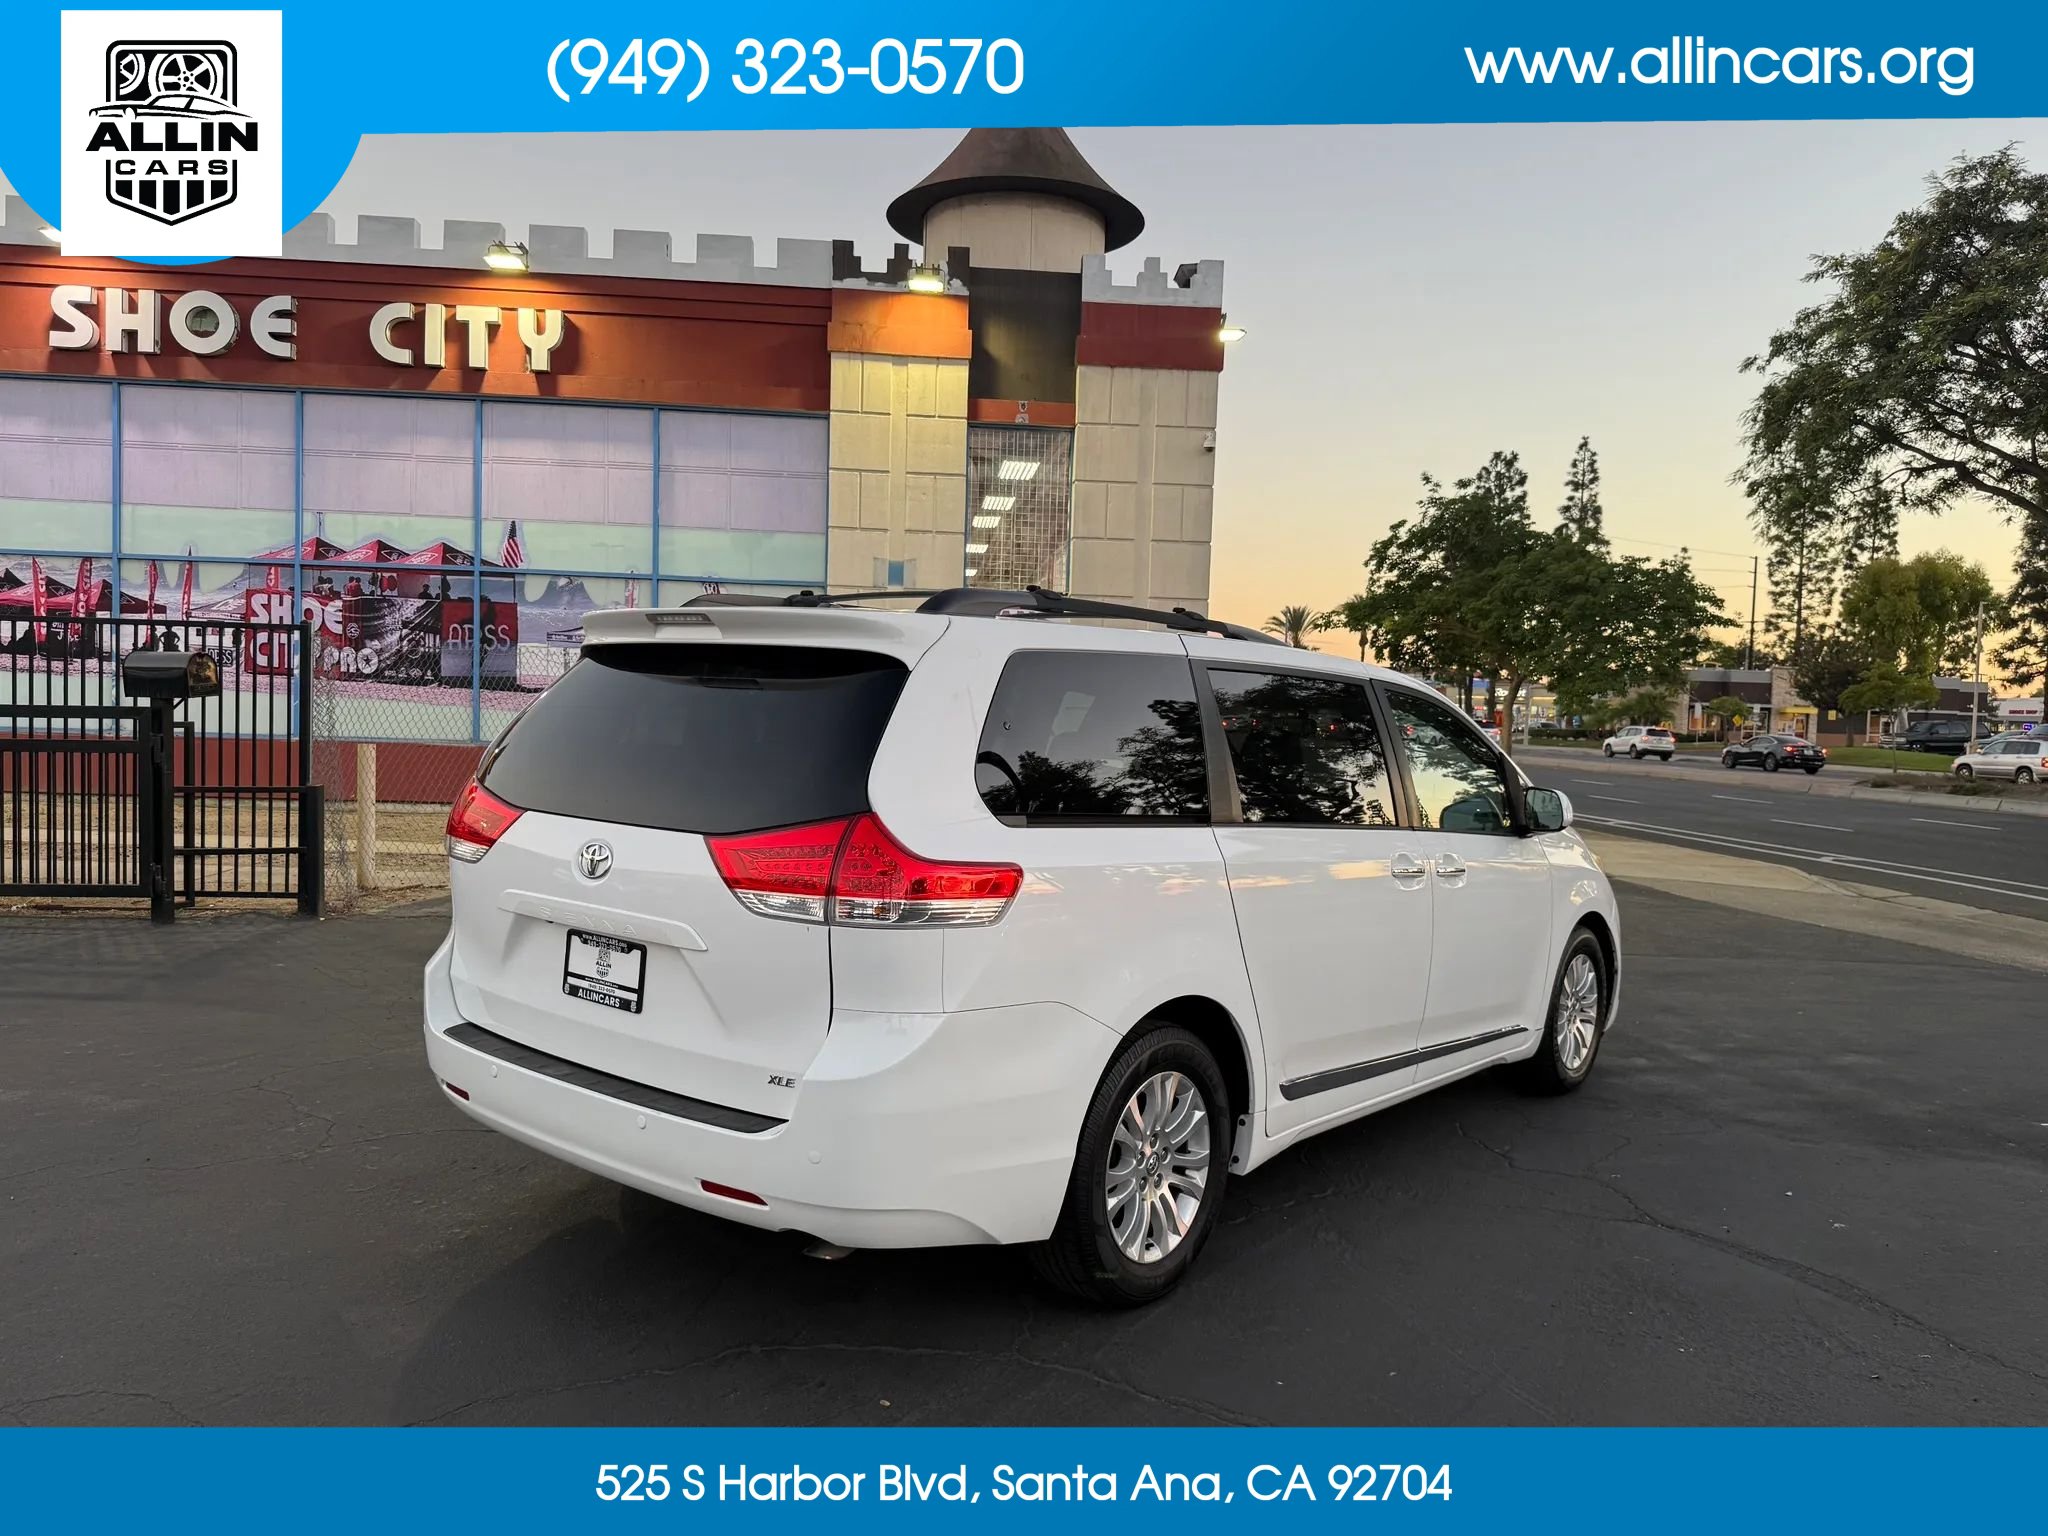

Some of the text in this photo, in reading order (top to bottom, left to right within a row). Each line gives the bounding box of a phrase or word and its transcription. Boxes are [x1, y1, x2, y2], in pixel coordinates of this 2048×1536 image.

[48, 285, 565, 373] SHOE CITY
[577, 988, 620, 1007] ALLINCARS
[768, 1075, 796, 1088] XLE
